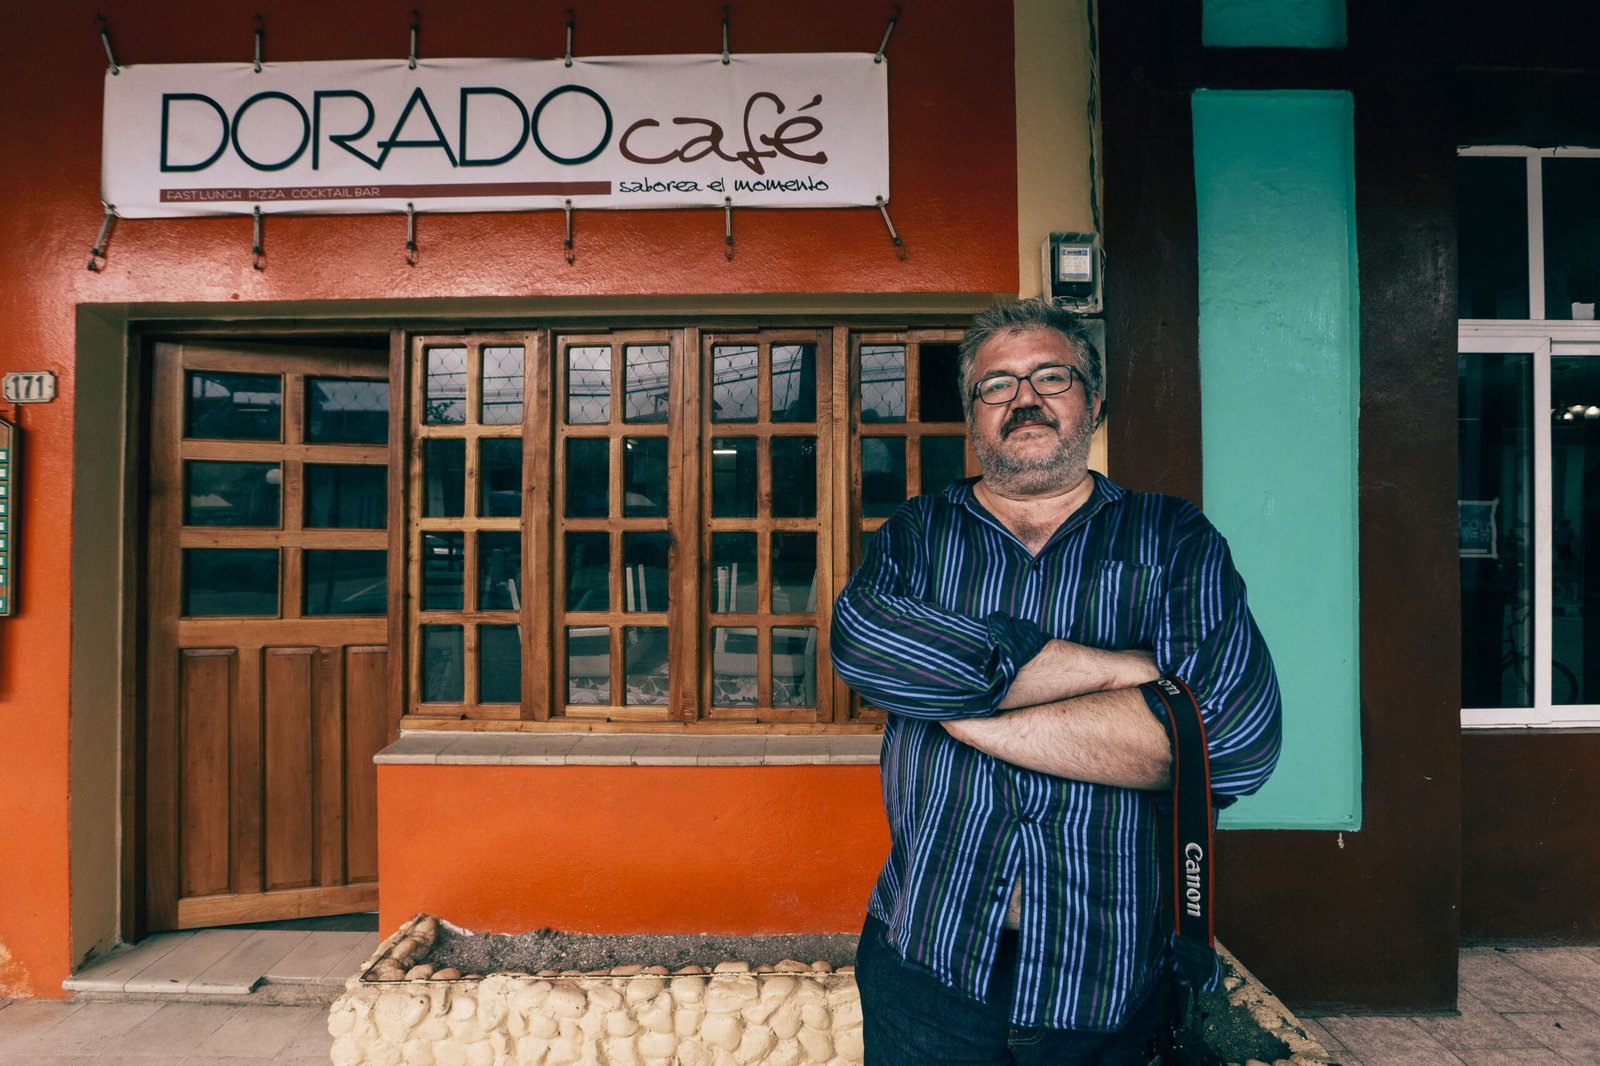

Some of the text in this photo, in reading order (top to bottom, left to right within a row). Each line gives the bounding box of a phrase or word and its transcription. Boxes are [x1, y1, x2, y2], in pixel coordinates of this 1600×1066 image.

[160, 84, 828, 175] DORADO café
[166, 187, 380, 200] FAST LUNCH PIZZA COCKTAIL BAR
[619, 175, 829, 192] saborea el momento
[12, 375, 44, 400] 171
[1185, 842, 1203, 918] Canon
